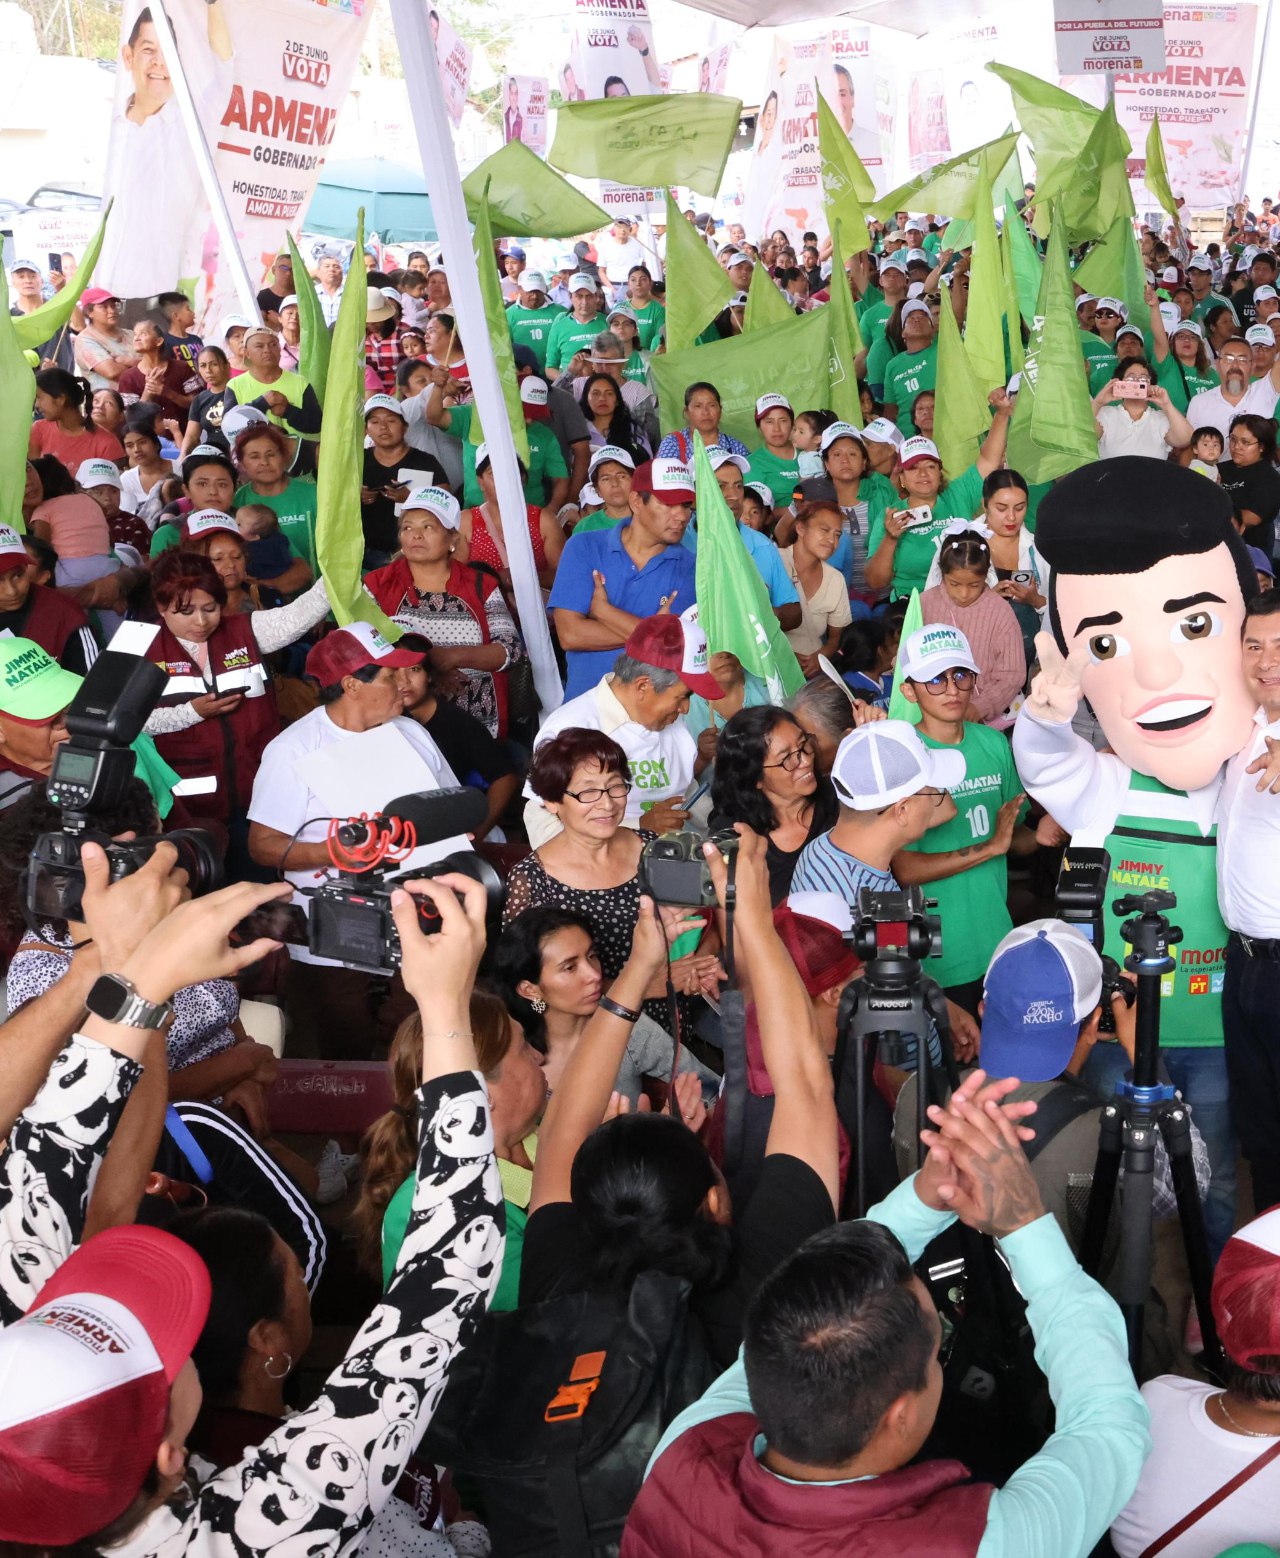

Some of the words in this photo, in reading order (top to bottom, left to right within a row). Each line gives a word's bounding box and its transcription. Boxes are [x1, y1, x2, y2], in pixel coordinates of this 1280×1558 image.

[1129, 20, 1160, 28] FUTURO
[589, 35, 618, 47] VOTA
[1093, 41, 1130, 51] VOTA
[285, 40, 290, 50] 2
[292, 44, 304, 55] DE
[305, 46, 328, 61] JUNIO
[284, 54, 328, 85] VOTA
[1083, 59, 1132, 70] morena
[1114, 65, 1246, 87] ARMENTA
[1139, 88, 1217, 98] GOBERNADOR
[790, 175, 816, 184] PUEBLA
[603, 191, 645, 204] morena
[247, 199, 274, 216] AMOR
[530, 329, 542, 339] 10
[904, 377, 920, 393] 10
[905, 437, 928, 448] JIMMY
[665, 466, 689, 474] JIMMY
[663, 473, 694, 482] NATALE
[421, 487, 449, 500] JIMMY
[416, 493, 450, 508] NATALE
[199, 513, 229, 521] JIMMY
[922, 630, 957, 645] JIMMY
[920, 639, 964, 655] NATALE
[4, 648, 39, 675] JIMMY
[5, 656, 52, 688] NATALE
[635, 774, 670, 790] GALI
[966, 804, 990, 838] 10
[1118, 860, 1164, 875] JIMMY
[1112, 870, 1170, 889] NATALE
[1190, 982, 1207, 994] PT
[1026, 1006, 1055, 1017] DON
[1023, 1012, 1062, 1025] NACHO
[56, 1322, 105, 1353] morena
